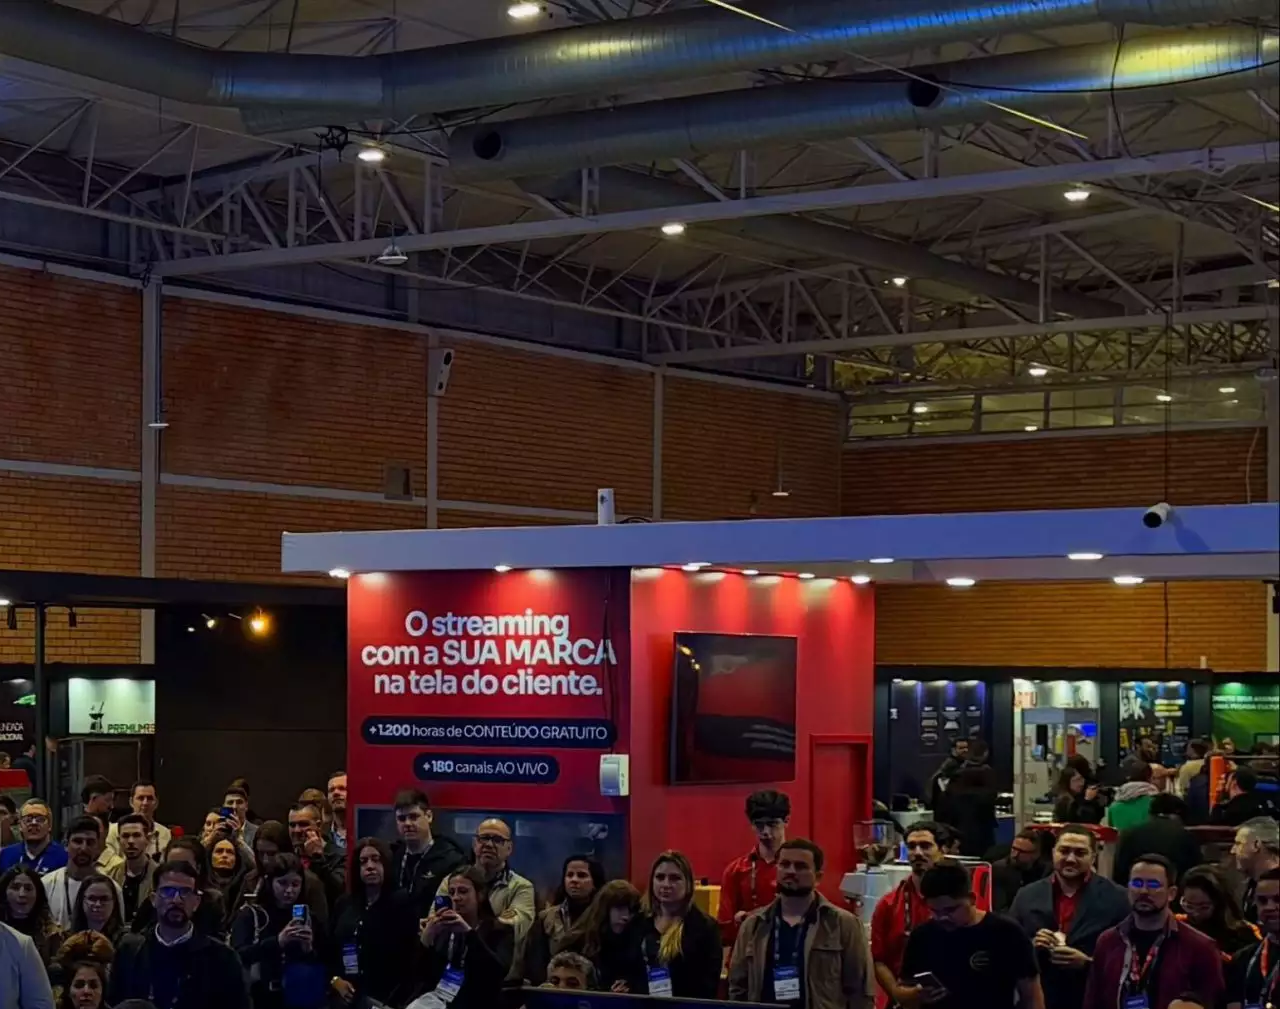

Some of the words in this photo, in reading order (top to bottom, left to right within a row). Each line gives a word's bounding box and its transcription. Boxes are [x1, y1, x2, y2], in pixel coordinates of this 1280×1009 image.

[404, 610, 428, 637] O
[431, 609, 570, 641] streaming
[361, 645, 420, 666] com
[423, 645, 439, 666] a
[442, 639, 499, 666] SUA
[505, 639, 618, 666] MARCA
[374, 673, 405, 695] na
[408, 669, 457, 696] tela
[461, 669, 498, 696] do
[502, 669, 604, 697] cliente.
[412, 725, 446, 738] horas
[447, 725, 463, 738] de
[463, 722, 539, 740] CONTEÚDO
[540, 725, 608, 740] GRATUITO
[422, 760, 454, 774] +180
[455, 761, 493, 775] canais
[494, 762, 515, 776] AO
[517, 762, 550, 776] VIVO
